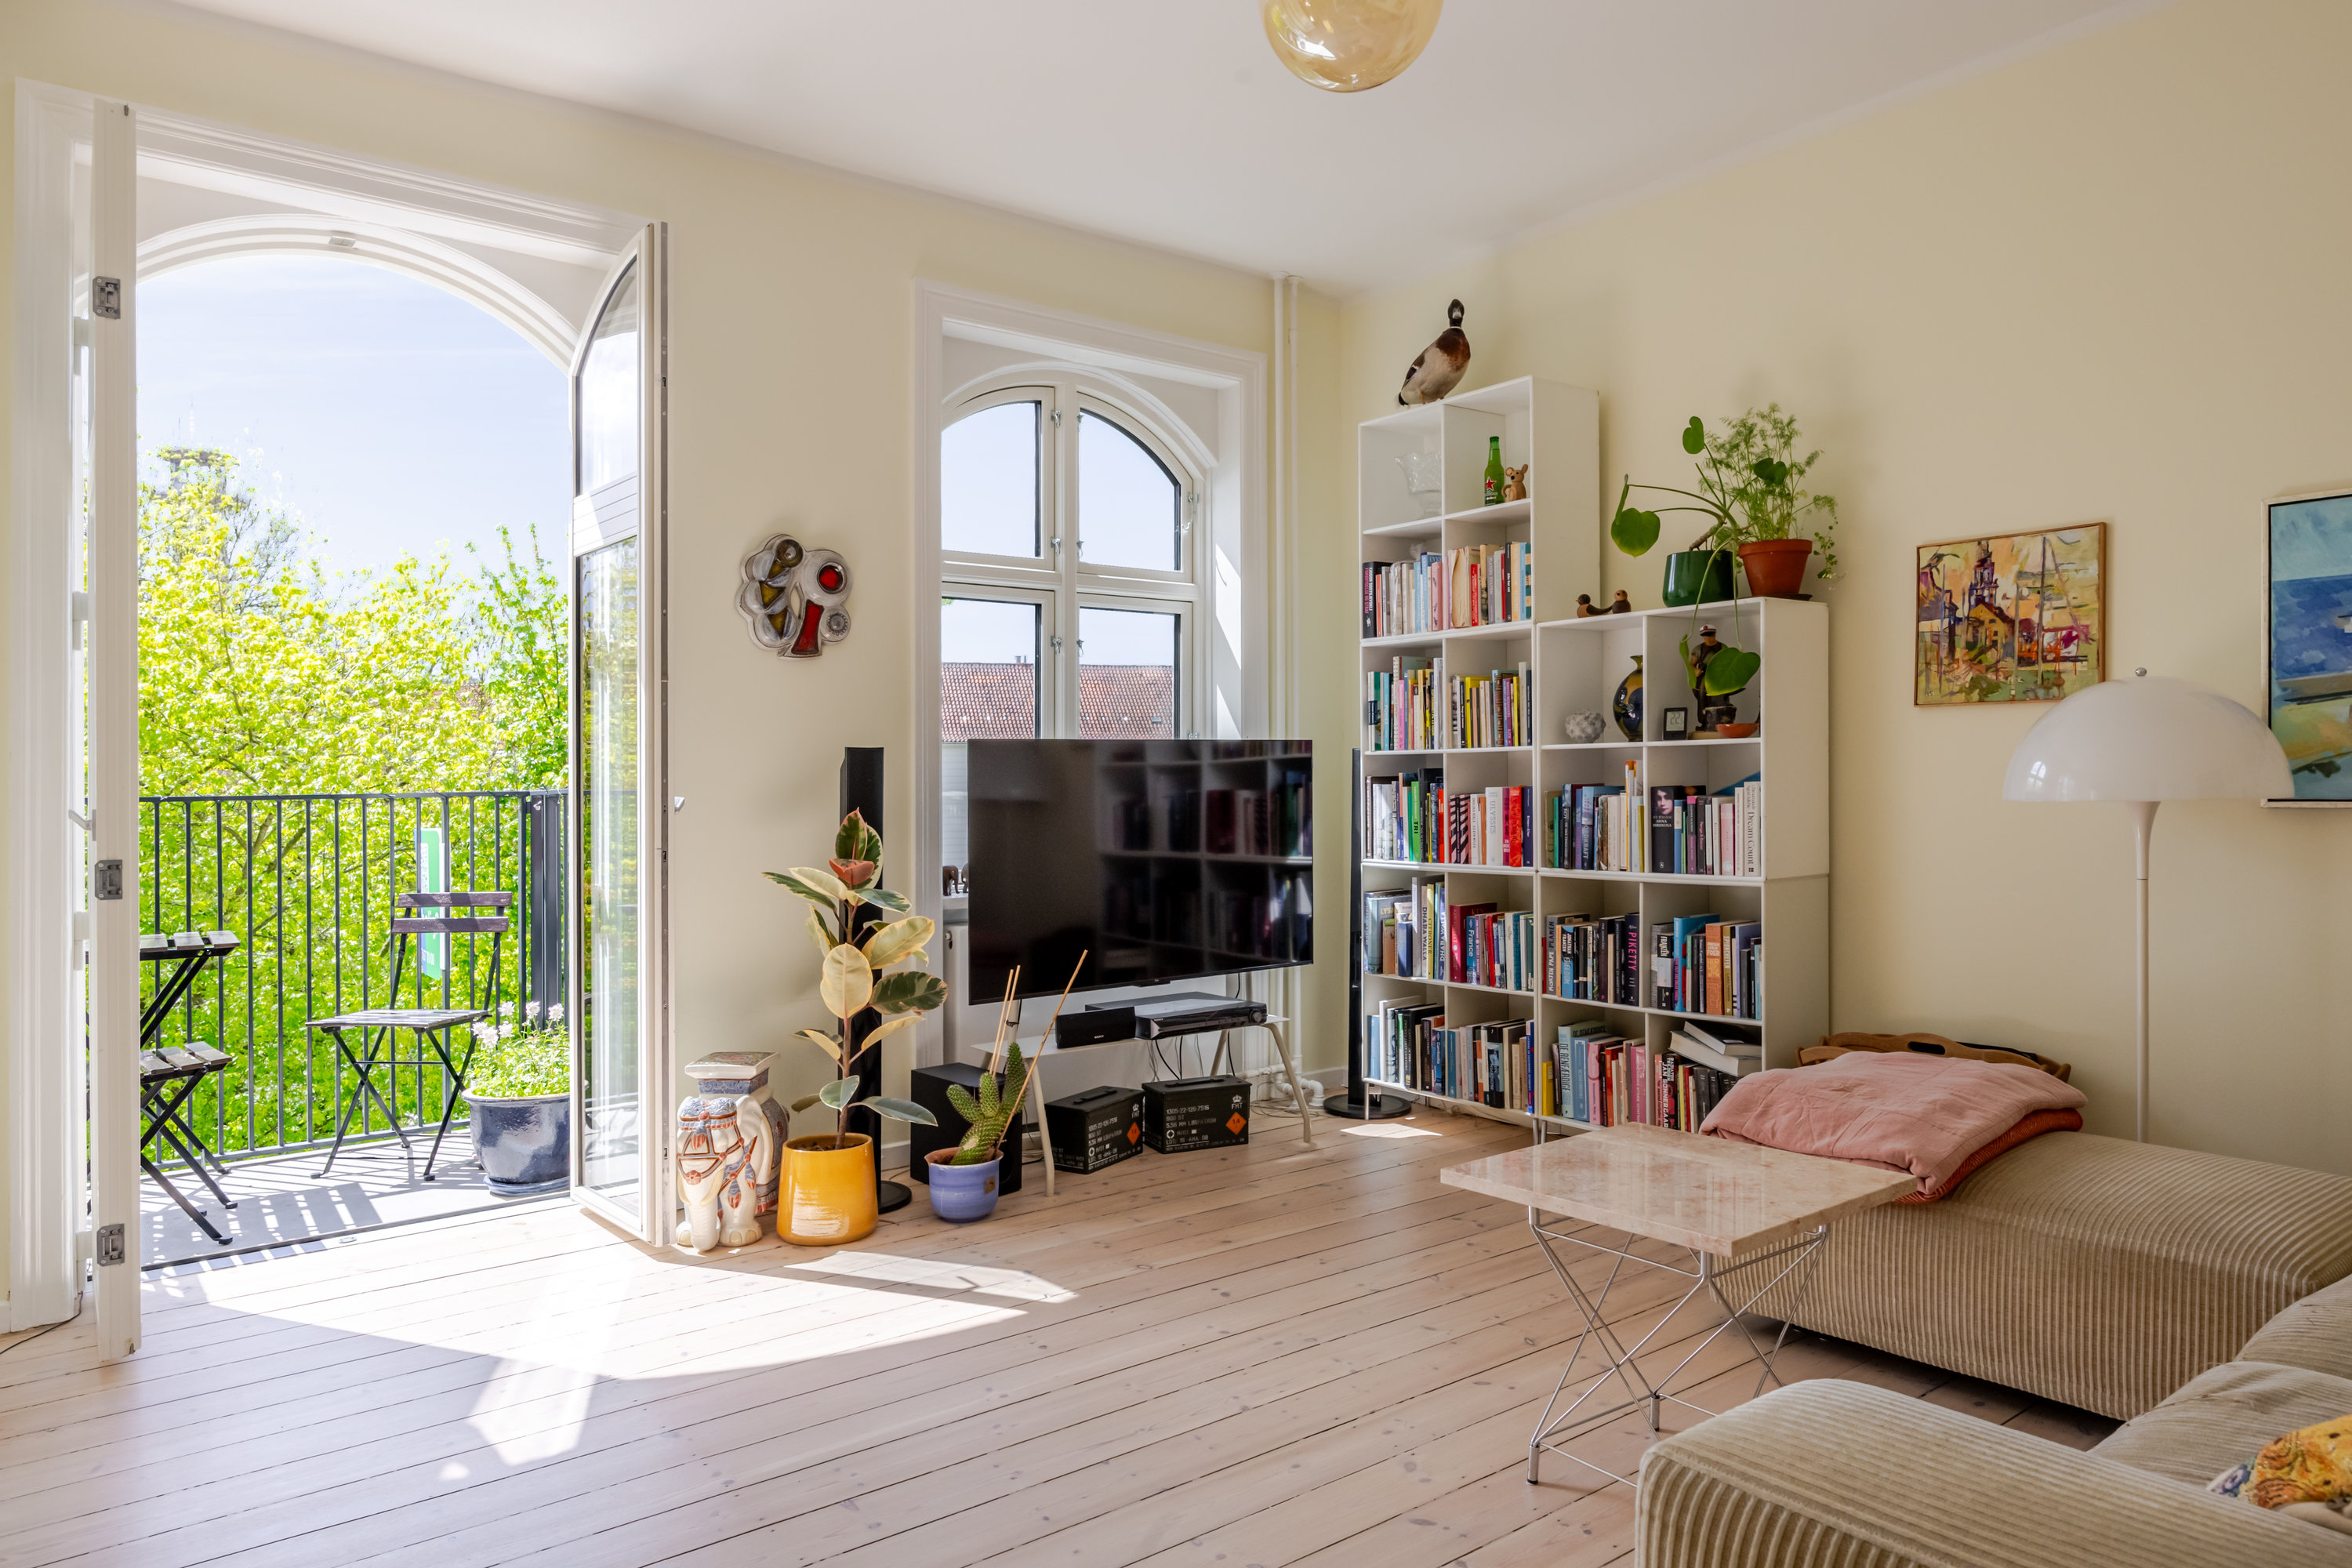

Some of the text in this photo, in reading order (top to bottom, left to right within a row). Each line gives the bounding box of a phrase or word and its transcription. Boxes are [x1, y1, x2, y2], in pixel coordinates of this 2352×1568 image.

[1628, 931, 1637, 971] PIKETTY
[1560, 1043, 1570, 1091] DE RENFÆRDIGE
